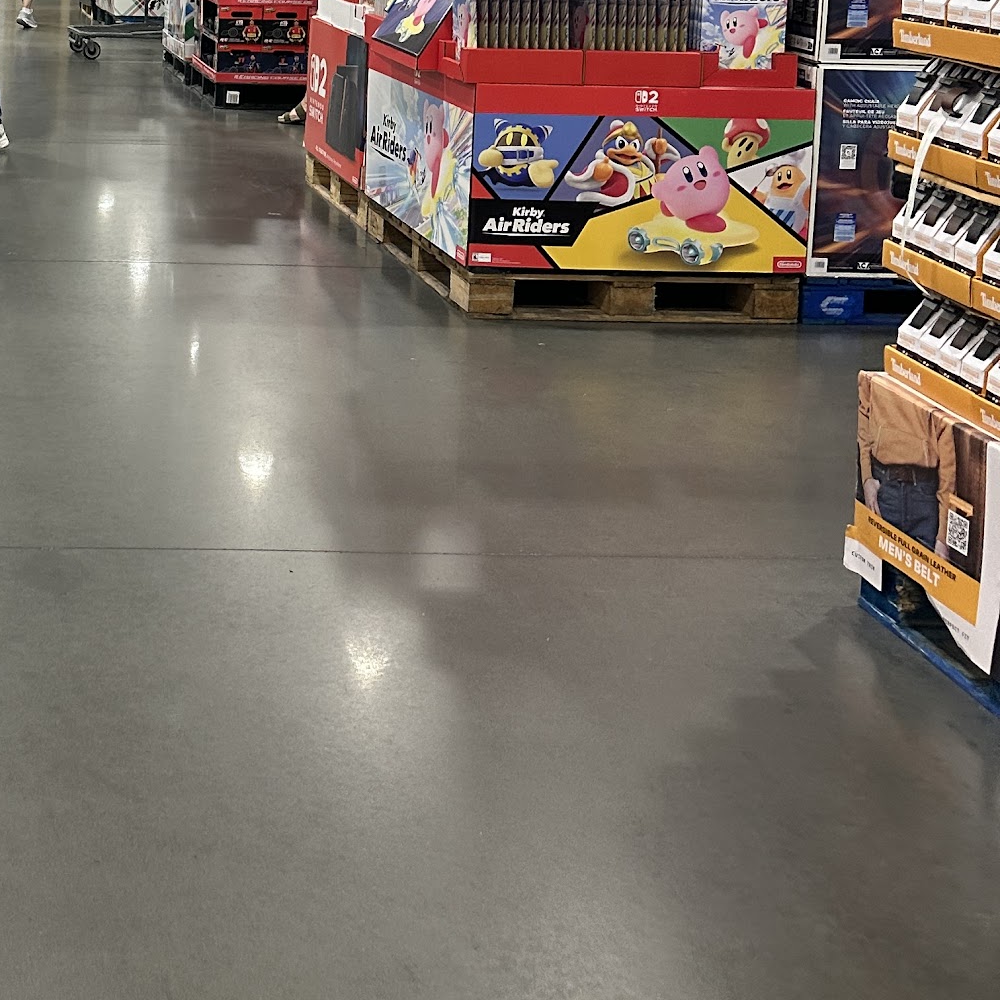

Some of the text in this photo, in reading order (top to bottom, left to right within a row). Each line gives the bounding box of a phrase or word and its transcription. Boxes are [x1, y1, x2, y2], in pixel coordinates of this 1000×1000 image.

[899, 28, 931, 47] Timberland
[319, 58, 328, 99] 2
[309, 106, 324, 125] SWITCH
[383, 114, 397, 133] Kirby
[512, 206, 545, 219] Kirby
[890, 358, 921, 386] Timberland
[867, 516, 957, 582] REVERSIBLE FULL GRAIN LEATHER
[878, 535, 941, 587] MEN'S BELT
